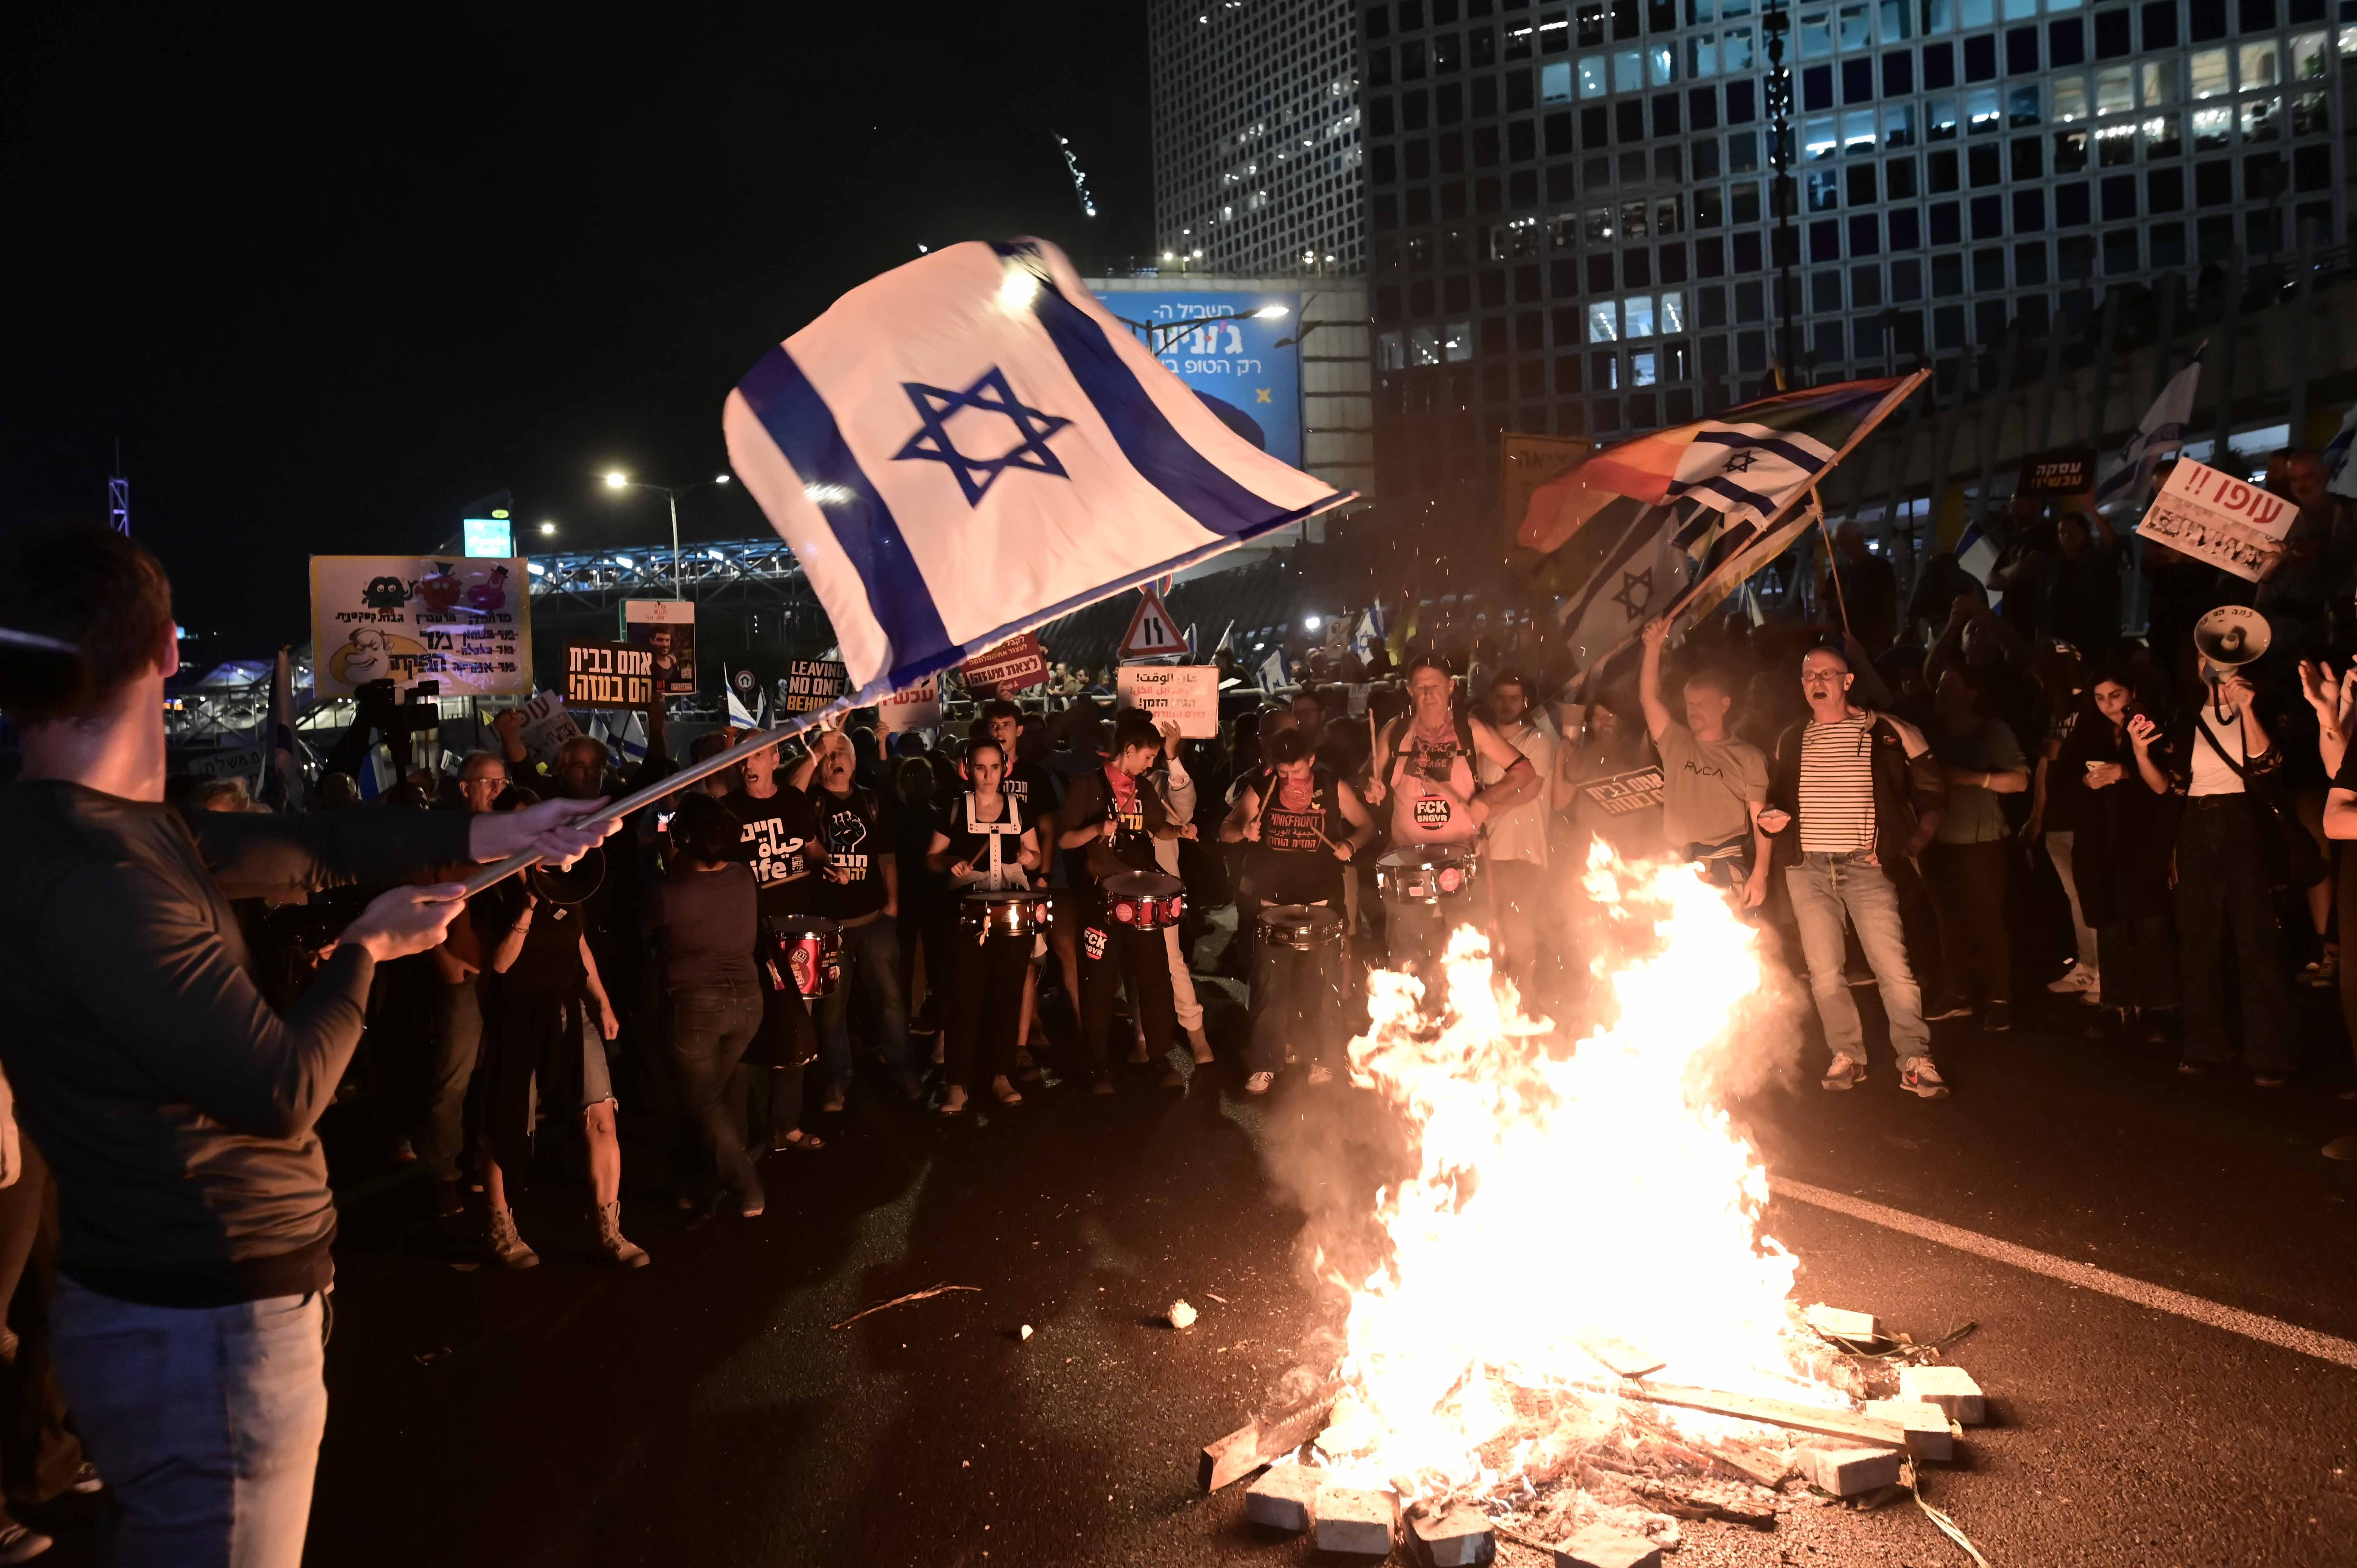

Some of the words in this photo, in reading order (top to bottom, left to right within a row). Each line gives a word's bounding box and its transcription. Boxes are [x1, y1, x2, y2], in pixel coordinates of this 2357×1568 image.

[1184, 359, 1230, 374] הטופ
[1237, 359, 1261, 376] רק
[2036, 462, 2082, 477] עסקה
[2213, 480, 2283, 524] עופו
[570, 647, 612, 673] בבית
[617, 650, 652, 676] אתם
[791, 660, 846, 678] LEAVING
[1005, 657, 1038, 676] לצאת
[969, 667, 1005, 683] מעזה!
[1136, 672, 1173, 685] الوقت!
[570, 674, 624, 703] בעזה!
[629, 677, 652, 703] הם
[789, 676, 806, 694] NO
[812, 678, 844, 696] ONE
[1139, 698, 1168, 710] הזמן!
[1585, 782, 1633, 801] בבית
[1417, 801, 1447, 814] FCK
[829, 854, 868, 867] חוב
[749, 858, 787, 883] ife
[1084, 929, 1107, 949] FCK
[1085, 943, 1103, 957] NGVR
